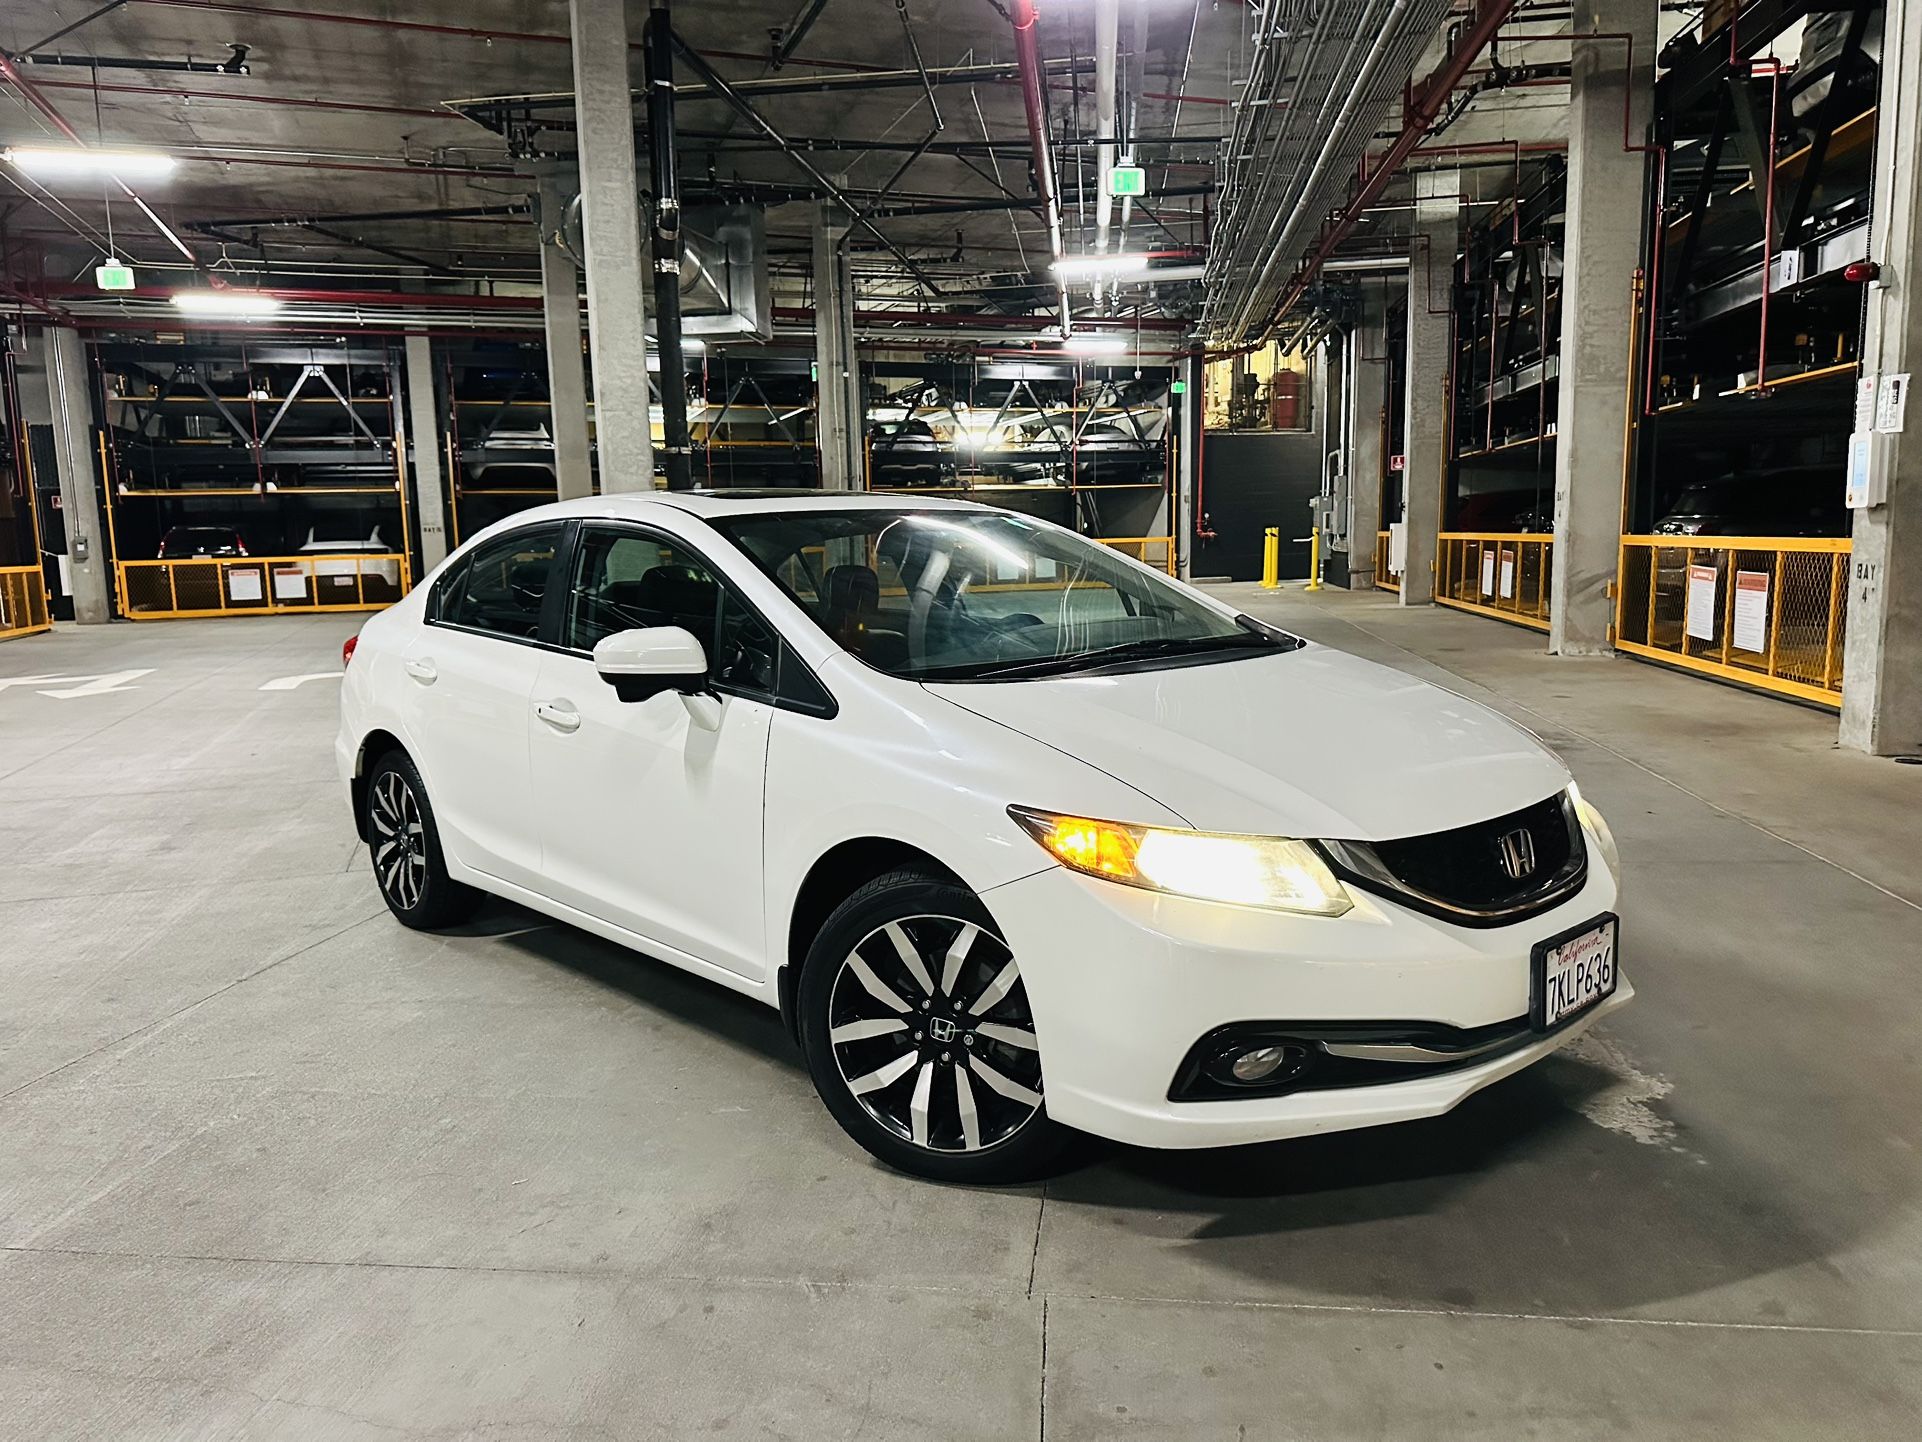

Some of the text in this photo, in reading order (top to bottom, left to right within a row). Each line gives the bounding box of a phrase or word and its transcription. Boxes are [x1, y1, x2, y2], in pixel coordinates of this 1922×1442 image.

[1856, 563, 1876, 581] BAY
[1557, 935, 1603, 967] California
[1548, 946, 1611, 1016] 7KLP636
